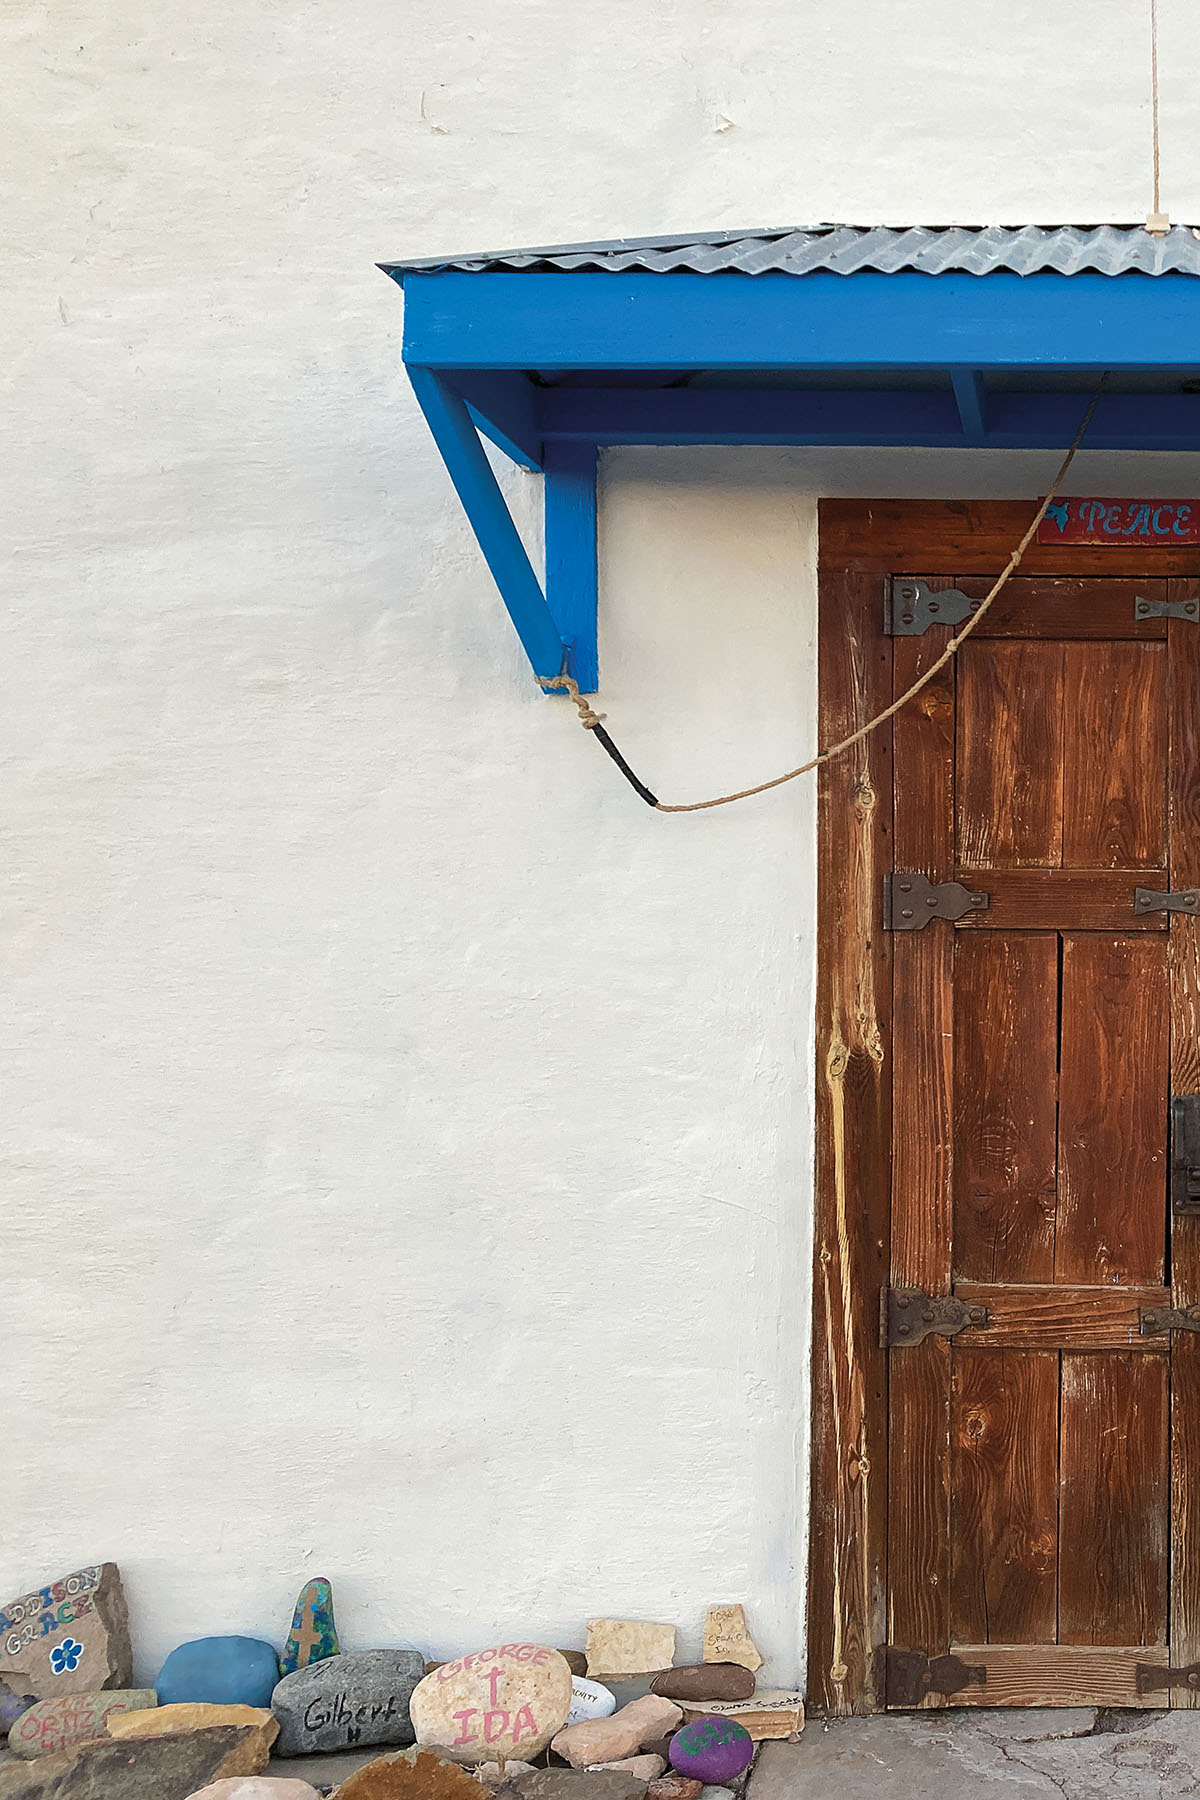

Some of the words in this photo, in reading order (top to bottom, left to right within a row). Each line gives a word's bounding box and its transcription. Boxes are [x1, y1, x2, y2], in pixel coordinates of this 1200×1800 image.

[1079, 501, 1191, 535] PEACE
[6, 1594, 92, 1655] GRACE
[437, 1644, 554, 1683] GEORGE
[304, 1692, 397, 1731] Gilbert
[452, 1702, 539, 1745] IDA
